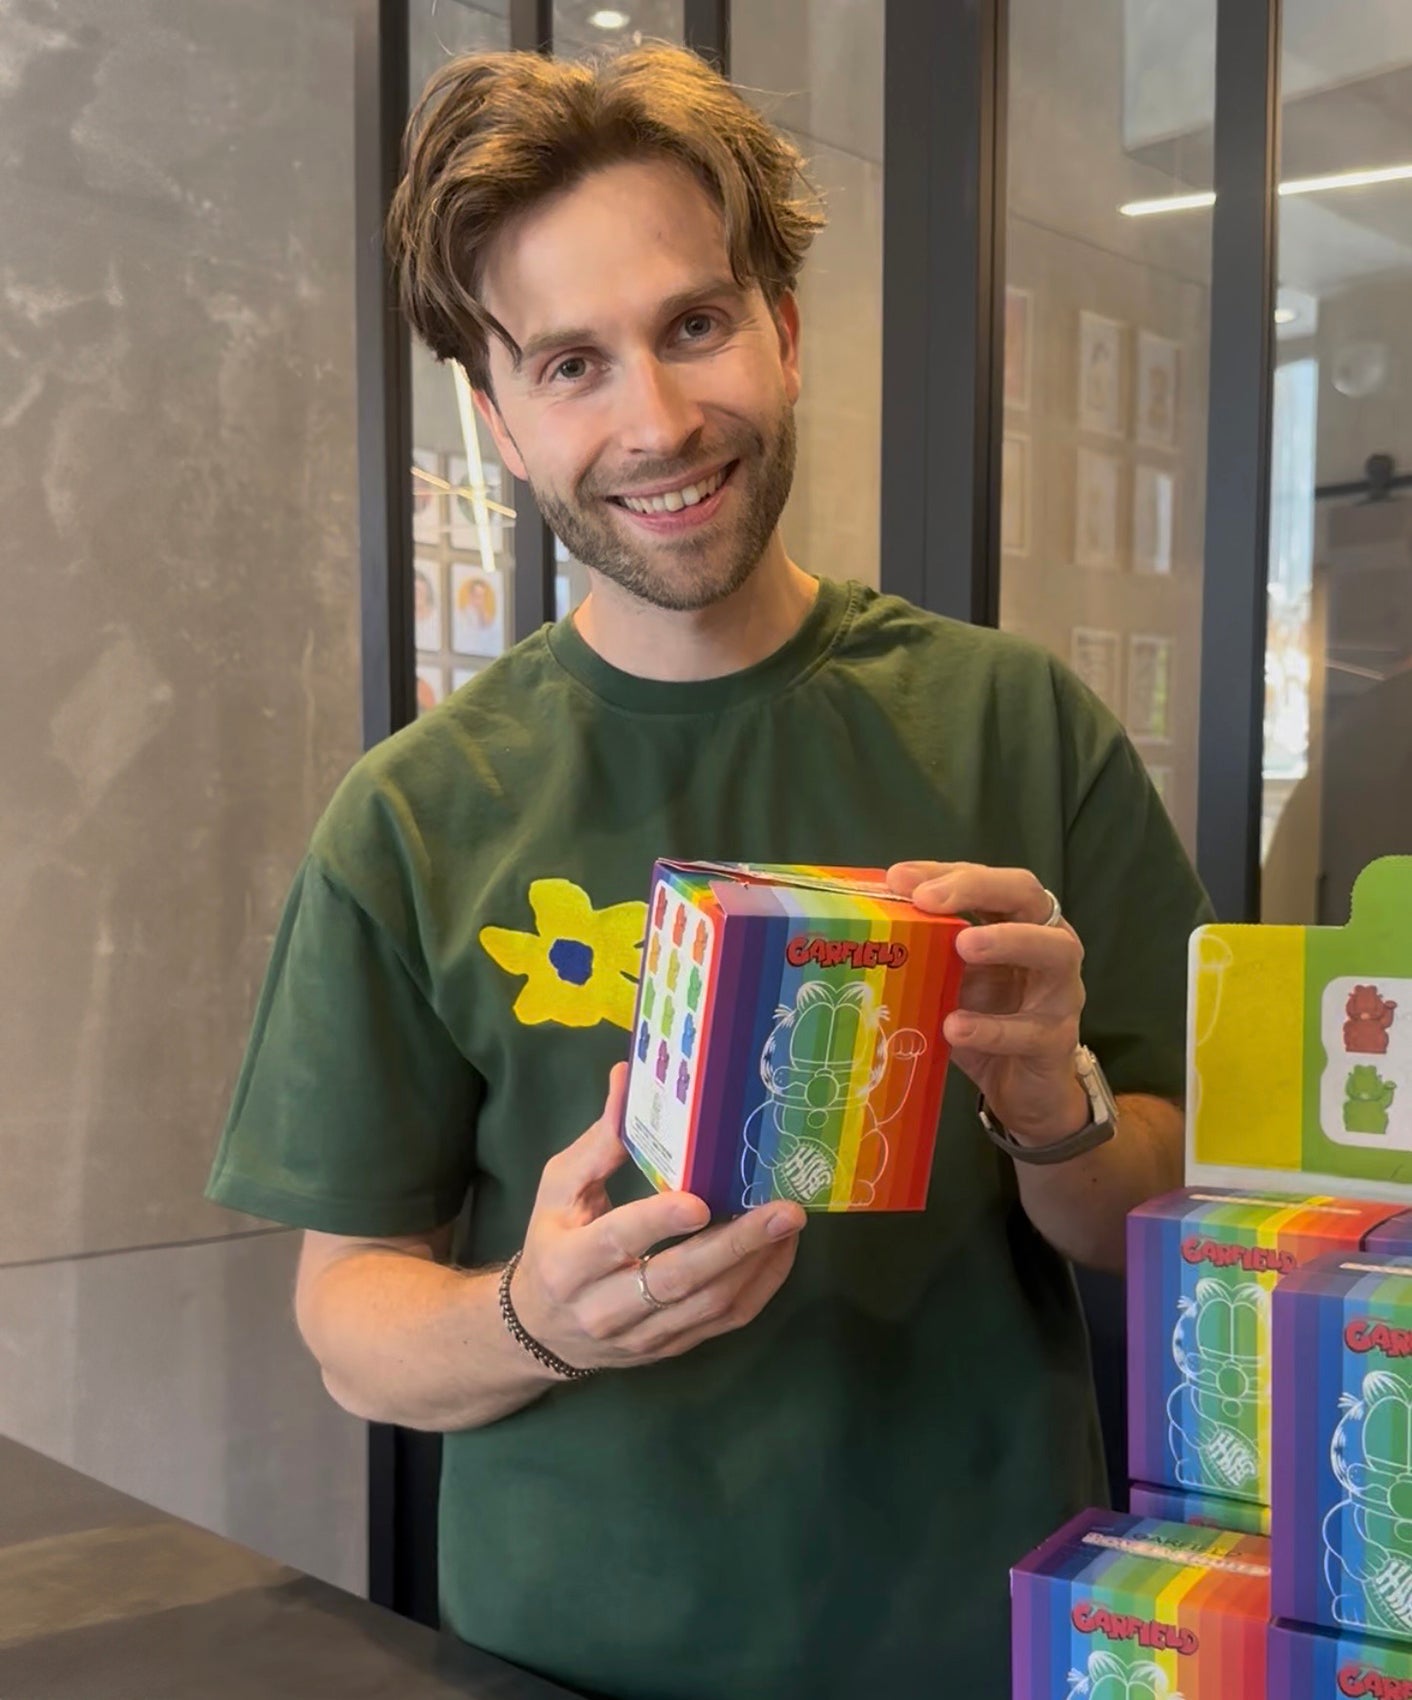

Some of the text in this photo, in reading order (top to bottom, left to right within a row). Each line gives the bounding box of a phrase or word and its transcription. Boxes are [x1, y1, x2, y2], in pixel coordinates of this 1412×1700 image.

[786, 935, 908, 969] GARFIELD
[1181, 1237, 1296, 1275] GARFIELD
[1344, 1319, 1412, 1359] GAR
[1071, 1602, 1199, 1656] GARFIELD
